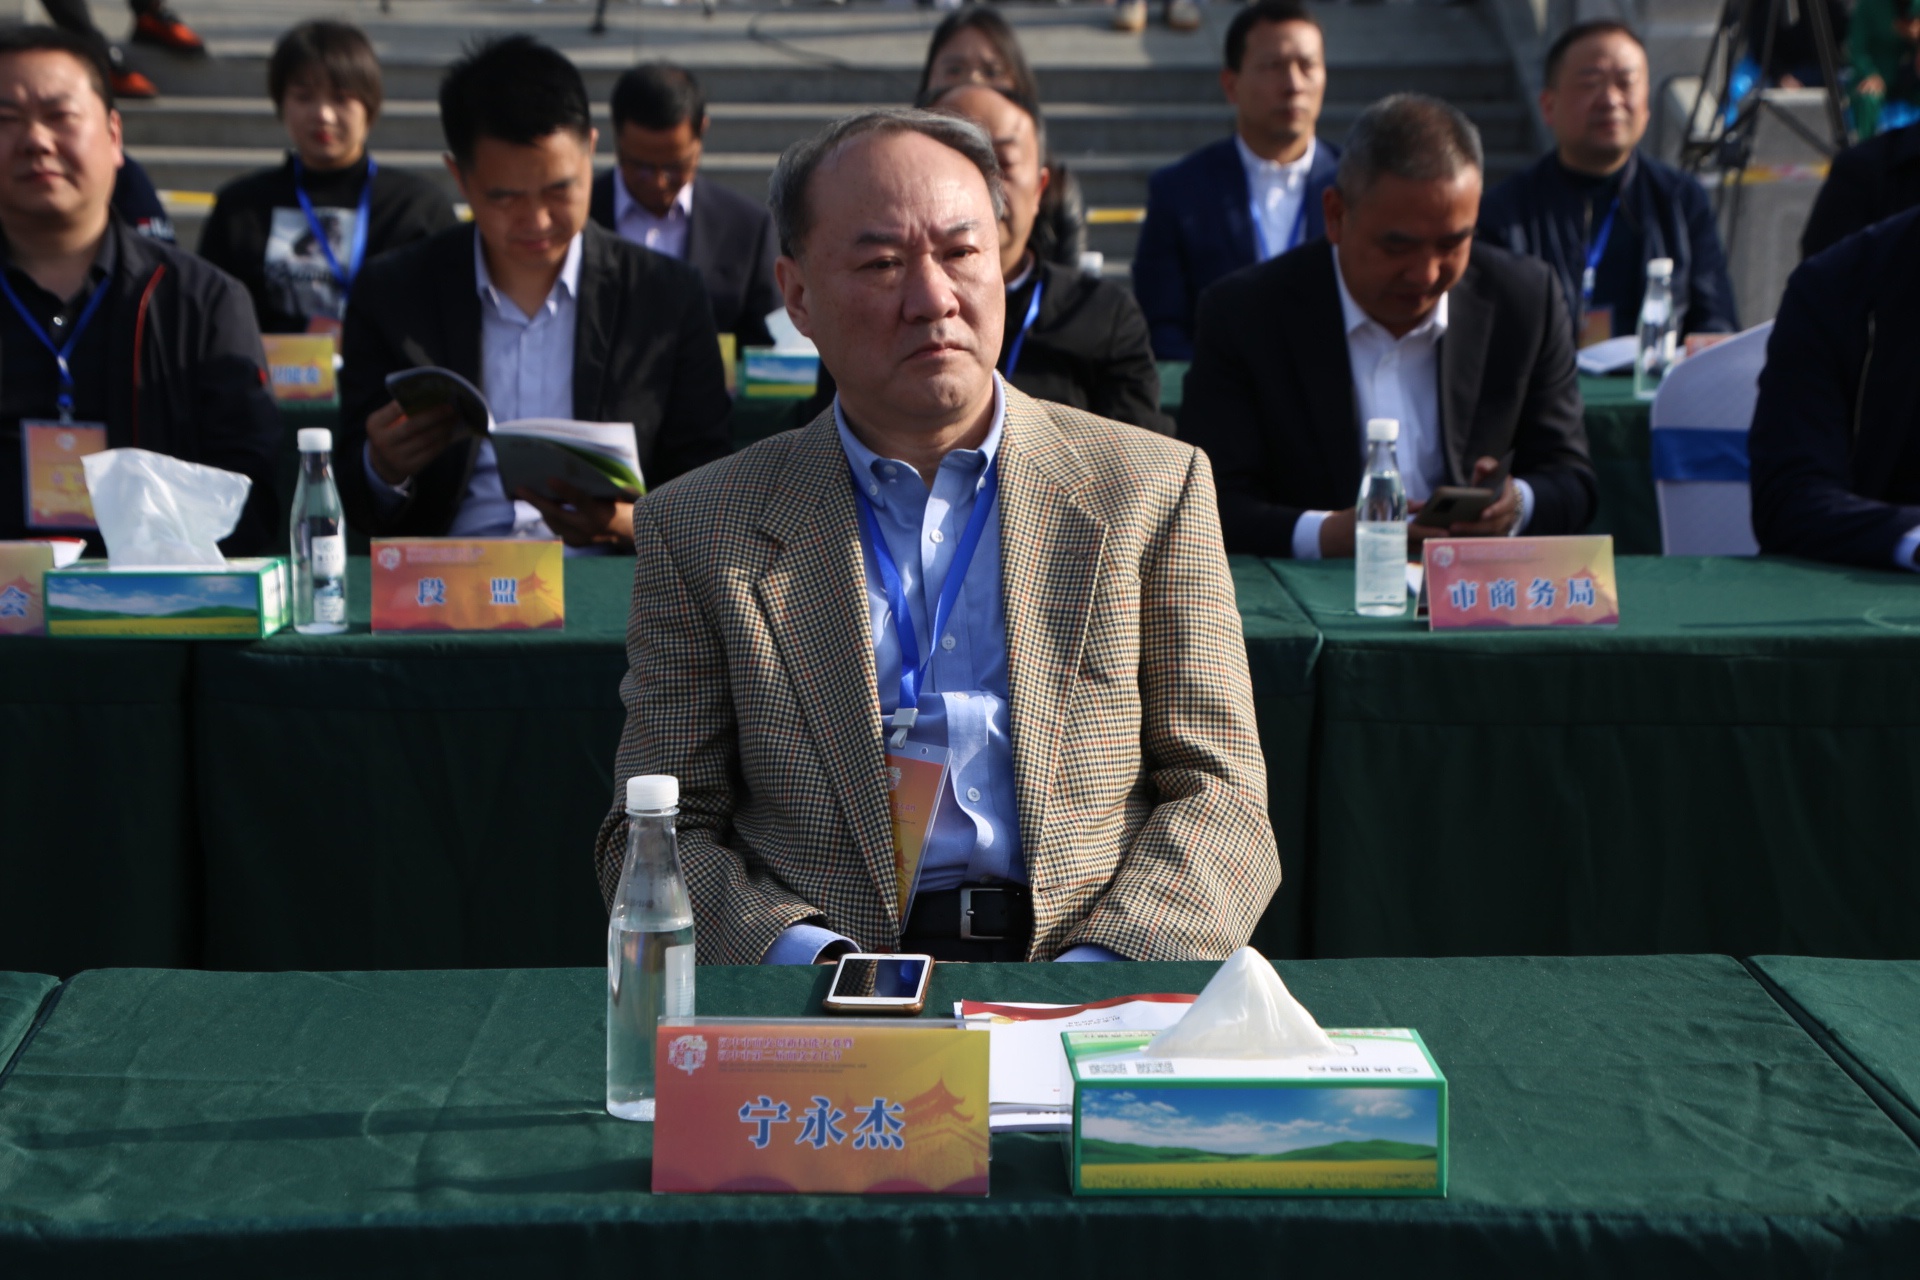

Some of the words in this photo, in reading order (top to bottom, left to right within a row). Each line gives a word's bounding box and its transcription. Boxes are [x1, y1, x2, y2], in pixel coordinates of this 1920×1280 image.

[417, 577, 518, 606] 段盟
[1448, 578, 1595, 611] 市商务局
[738, 1095, 906, 1150] 宁永杰
